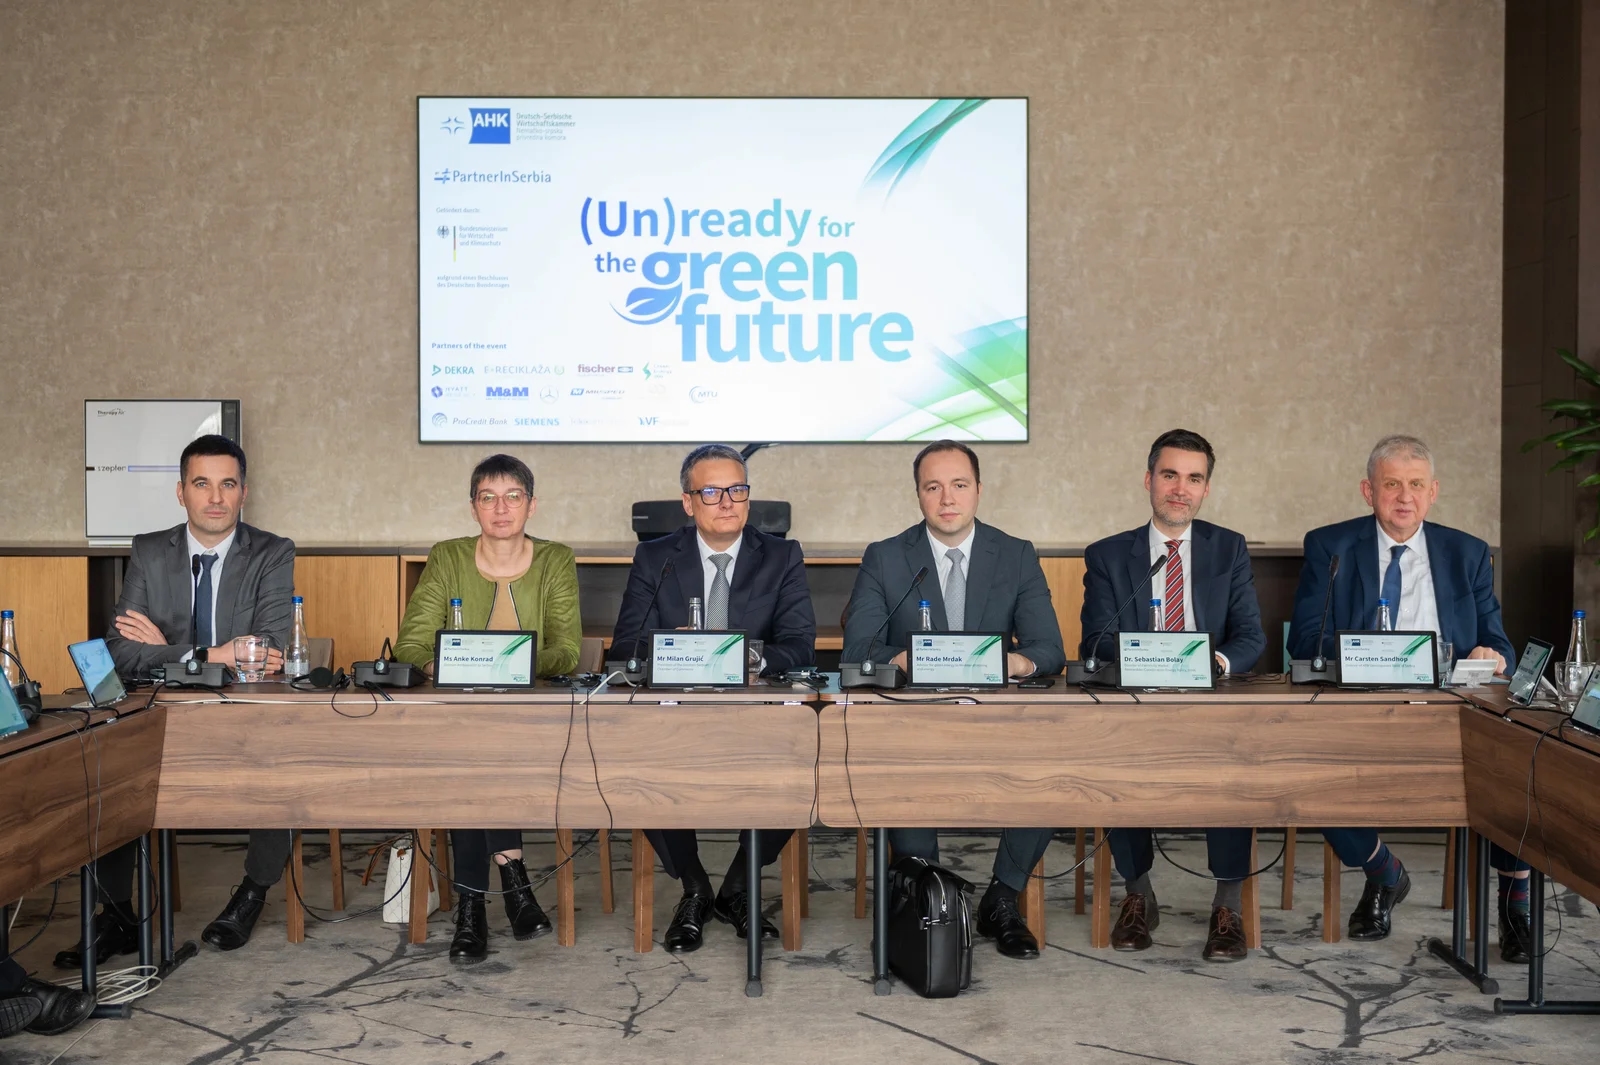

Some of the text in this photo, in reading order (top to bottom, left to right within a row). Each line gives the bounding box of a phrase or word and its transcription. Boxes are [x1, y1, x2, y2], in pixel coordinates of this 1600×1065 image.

[473, 113, 508, 127] AHK
[452, 170, 552, 183] PartnerInSerbia
[581, 197, 855, 247] (Un)ready for
[594, 251, 858, 325] the green
[675, 293, 914, 362] future
[445, 366, 475, 375] DEKRA
[577, 364, 615, 373] fischer
[486, 387, 529, 397] M&M
[452, 418, 486, 426] ProCredit
[514, 418, 560, 426] SIEMENS
[685, 655, 704, 663] Grujić
